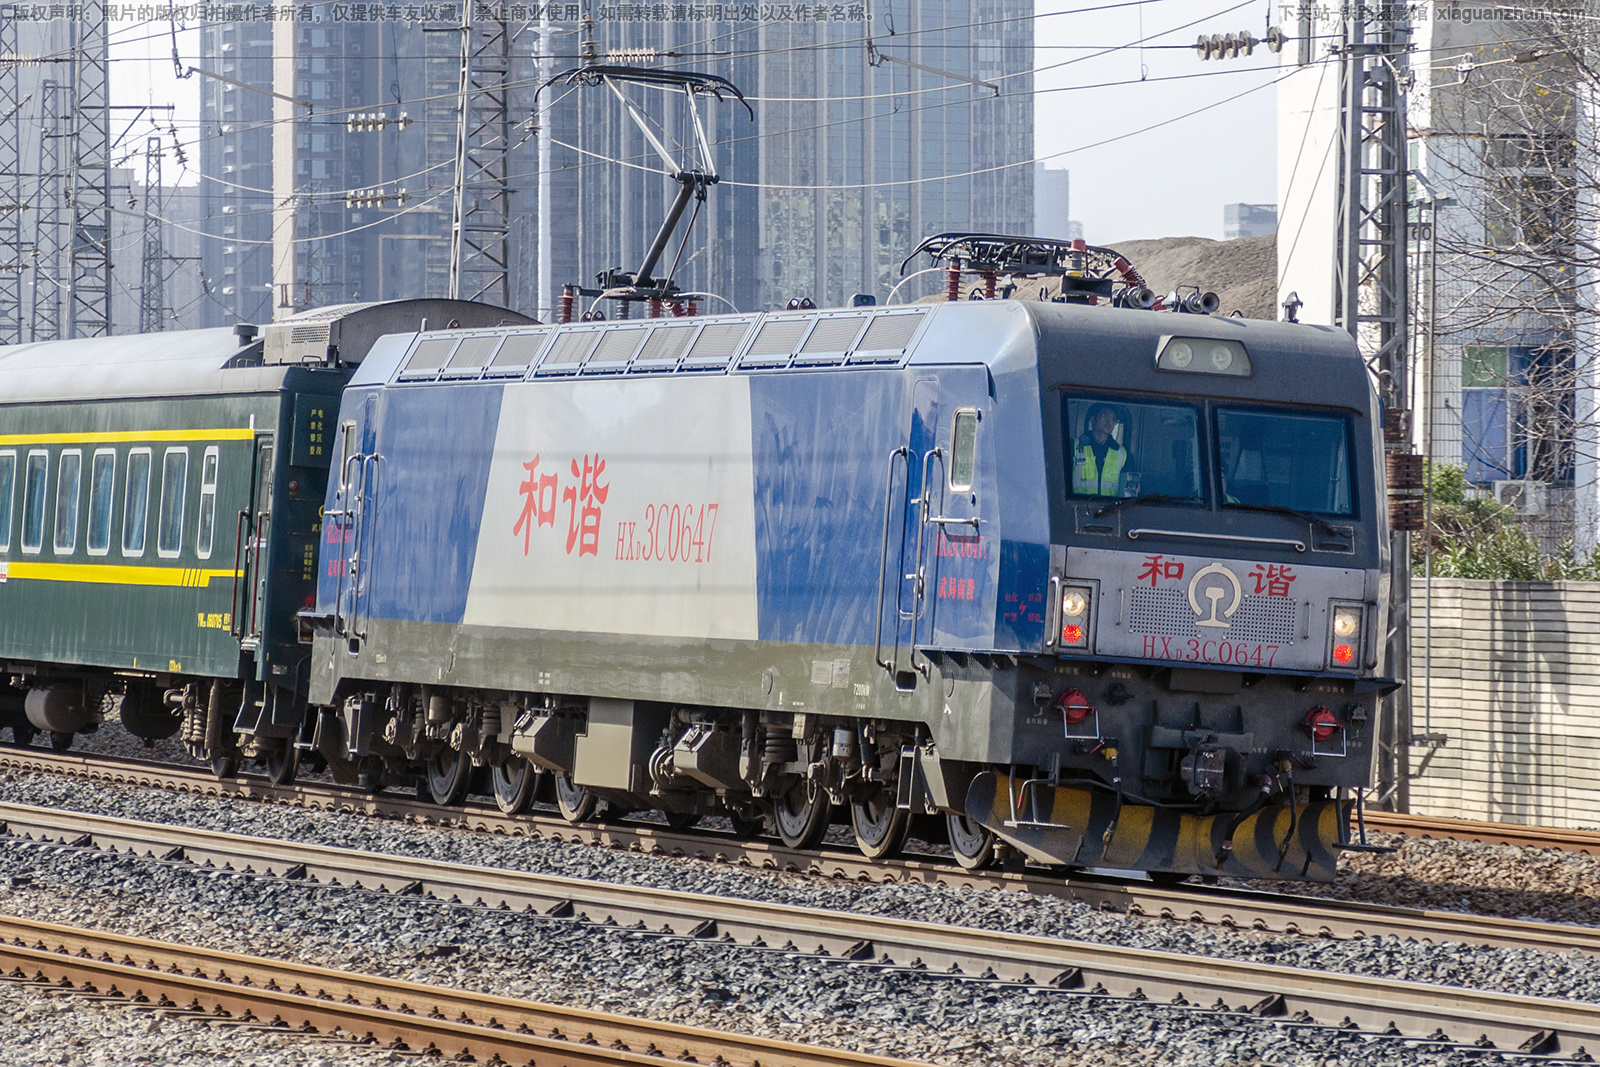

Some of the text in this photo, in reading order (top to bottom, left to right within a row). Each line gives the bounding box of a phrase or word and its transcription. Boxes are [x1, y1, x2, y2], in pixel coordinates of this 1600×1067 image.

[513, 453, 610, 558] 和谐
[615, 503, 719, 563] HXD3C0647
[1137, 554, 1297, 597] 和 谐
[1141, 635, 1280, 668] HXD3C0647
